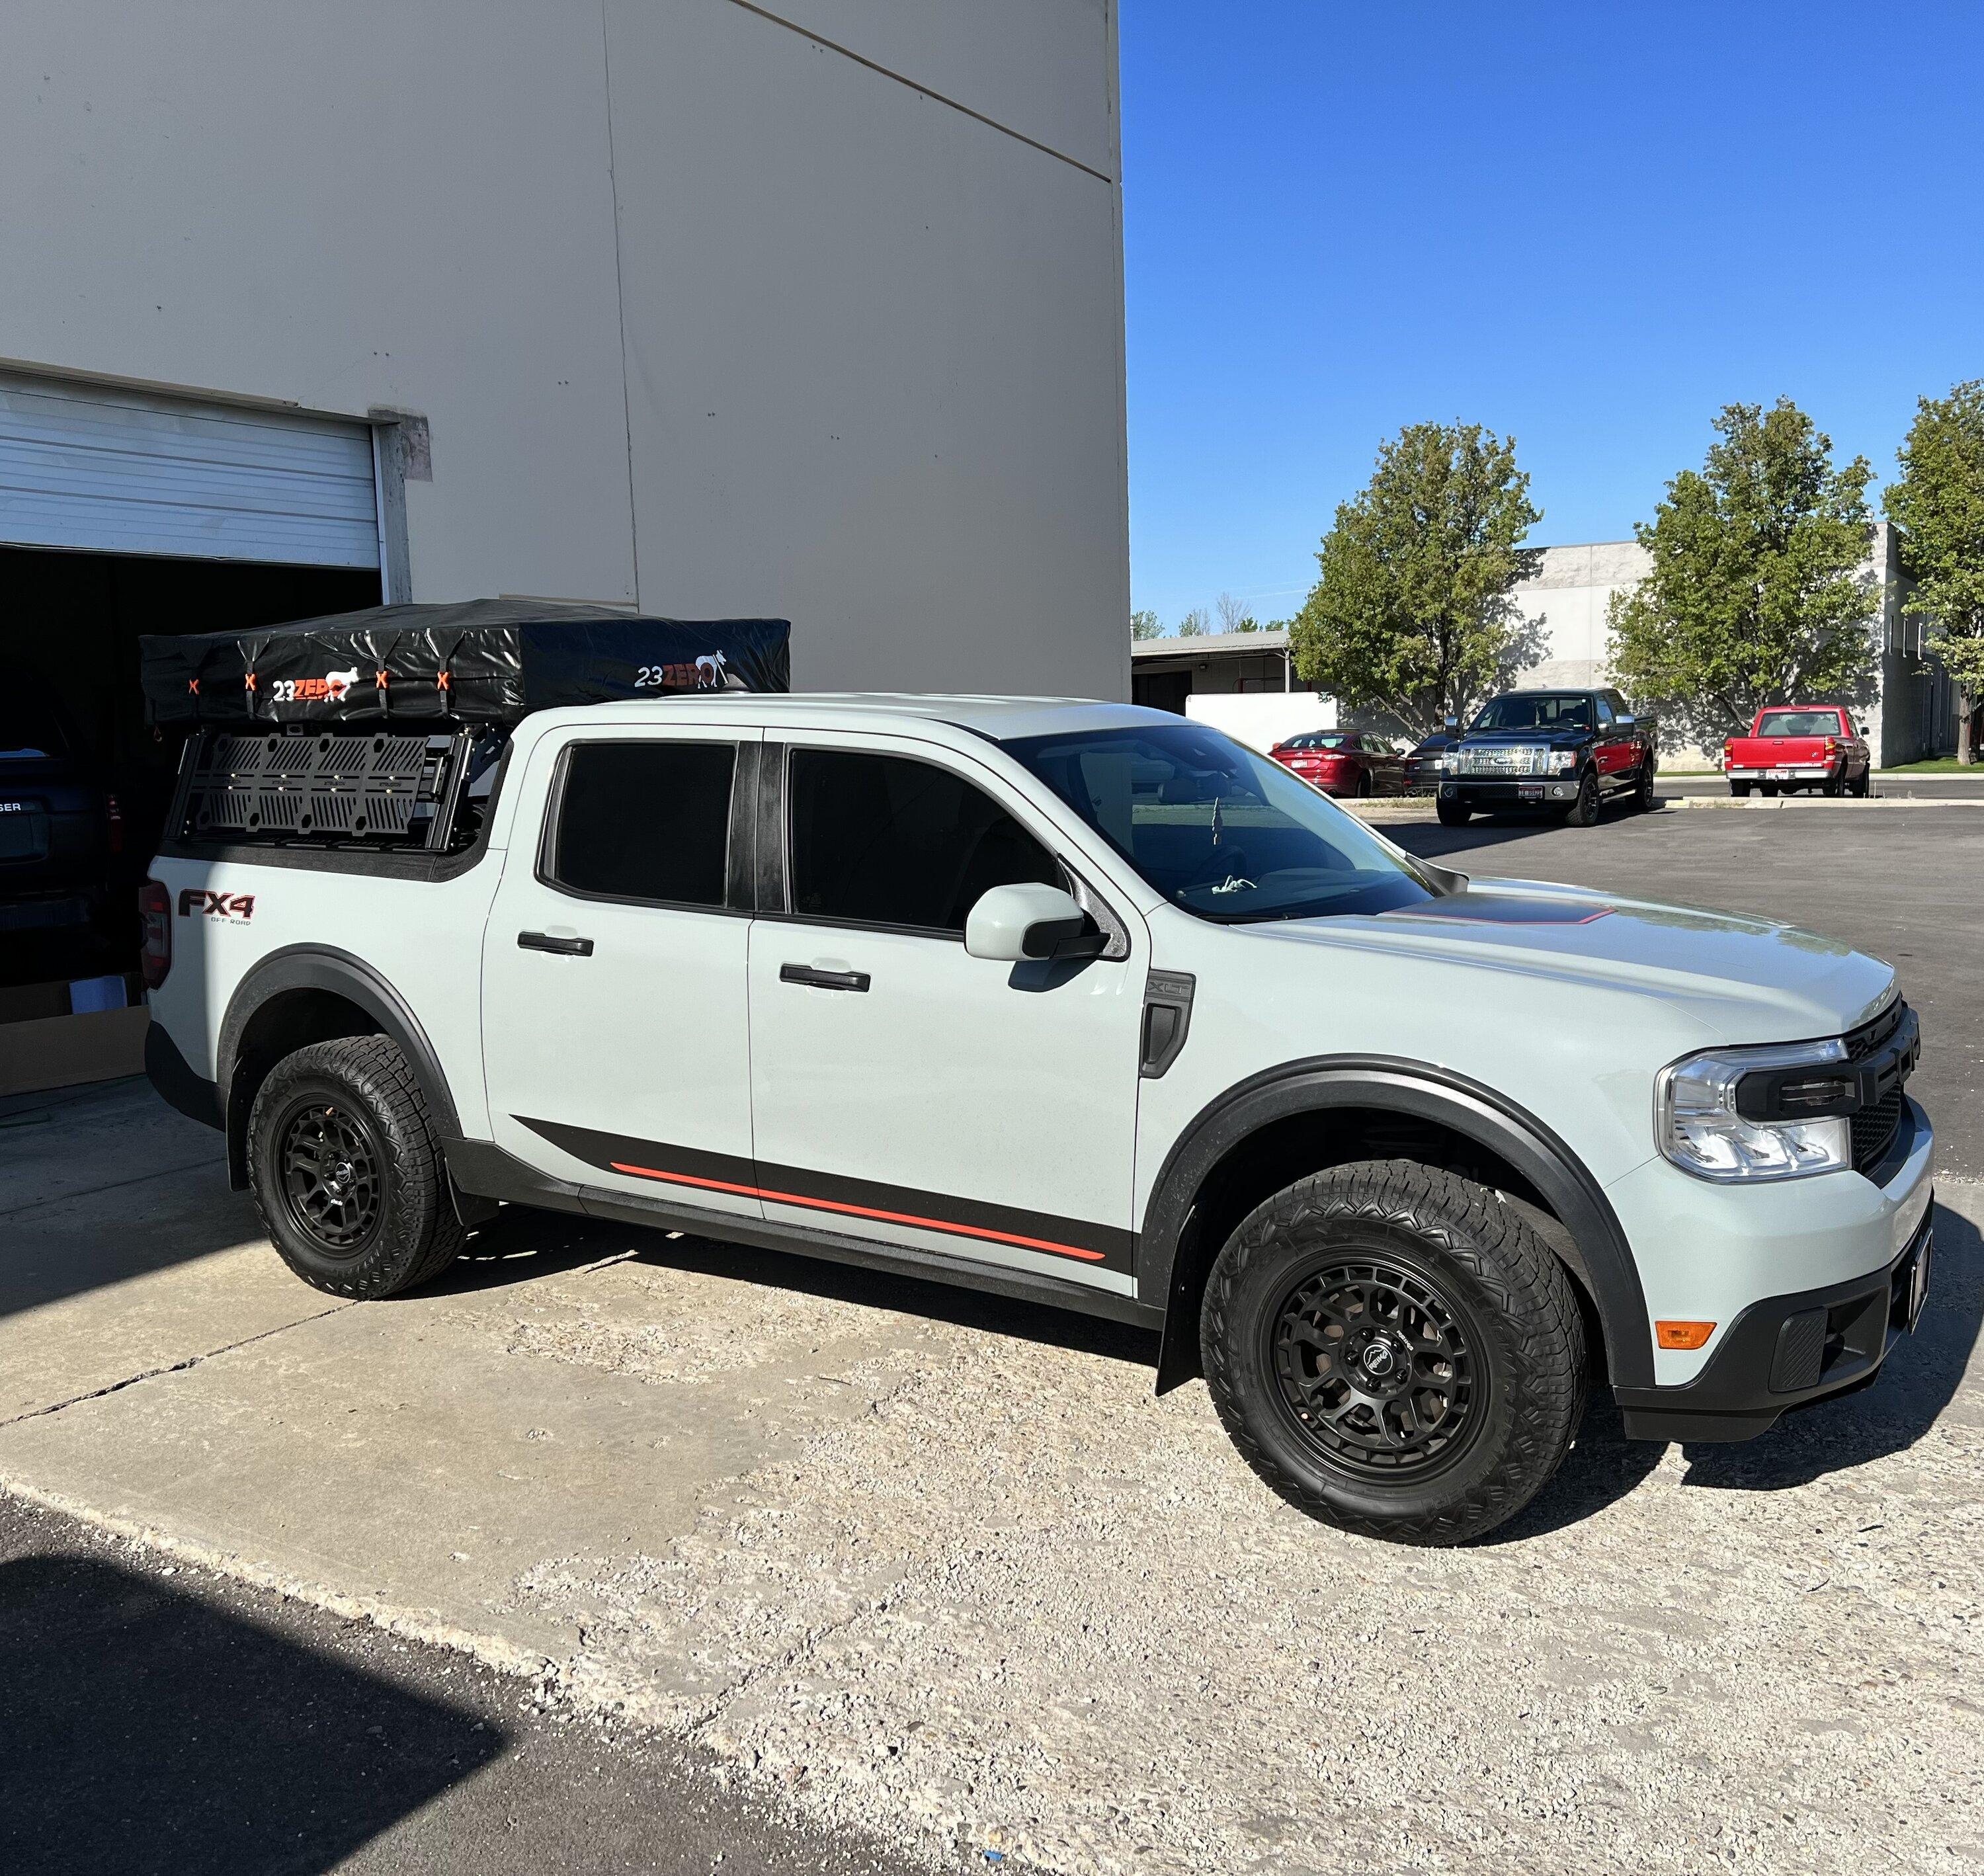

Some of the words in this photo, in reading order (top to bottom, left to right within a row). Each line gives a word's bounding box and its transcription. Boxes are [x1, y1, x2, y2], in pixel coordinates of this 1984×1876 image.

[634, 663, 714, 688] 23ZERO
[178, 888, 256, 920] FX4
[1147, 981, 1189, 995] XLT
